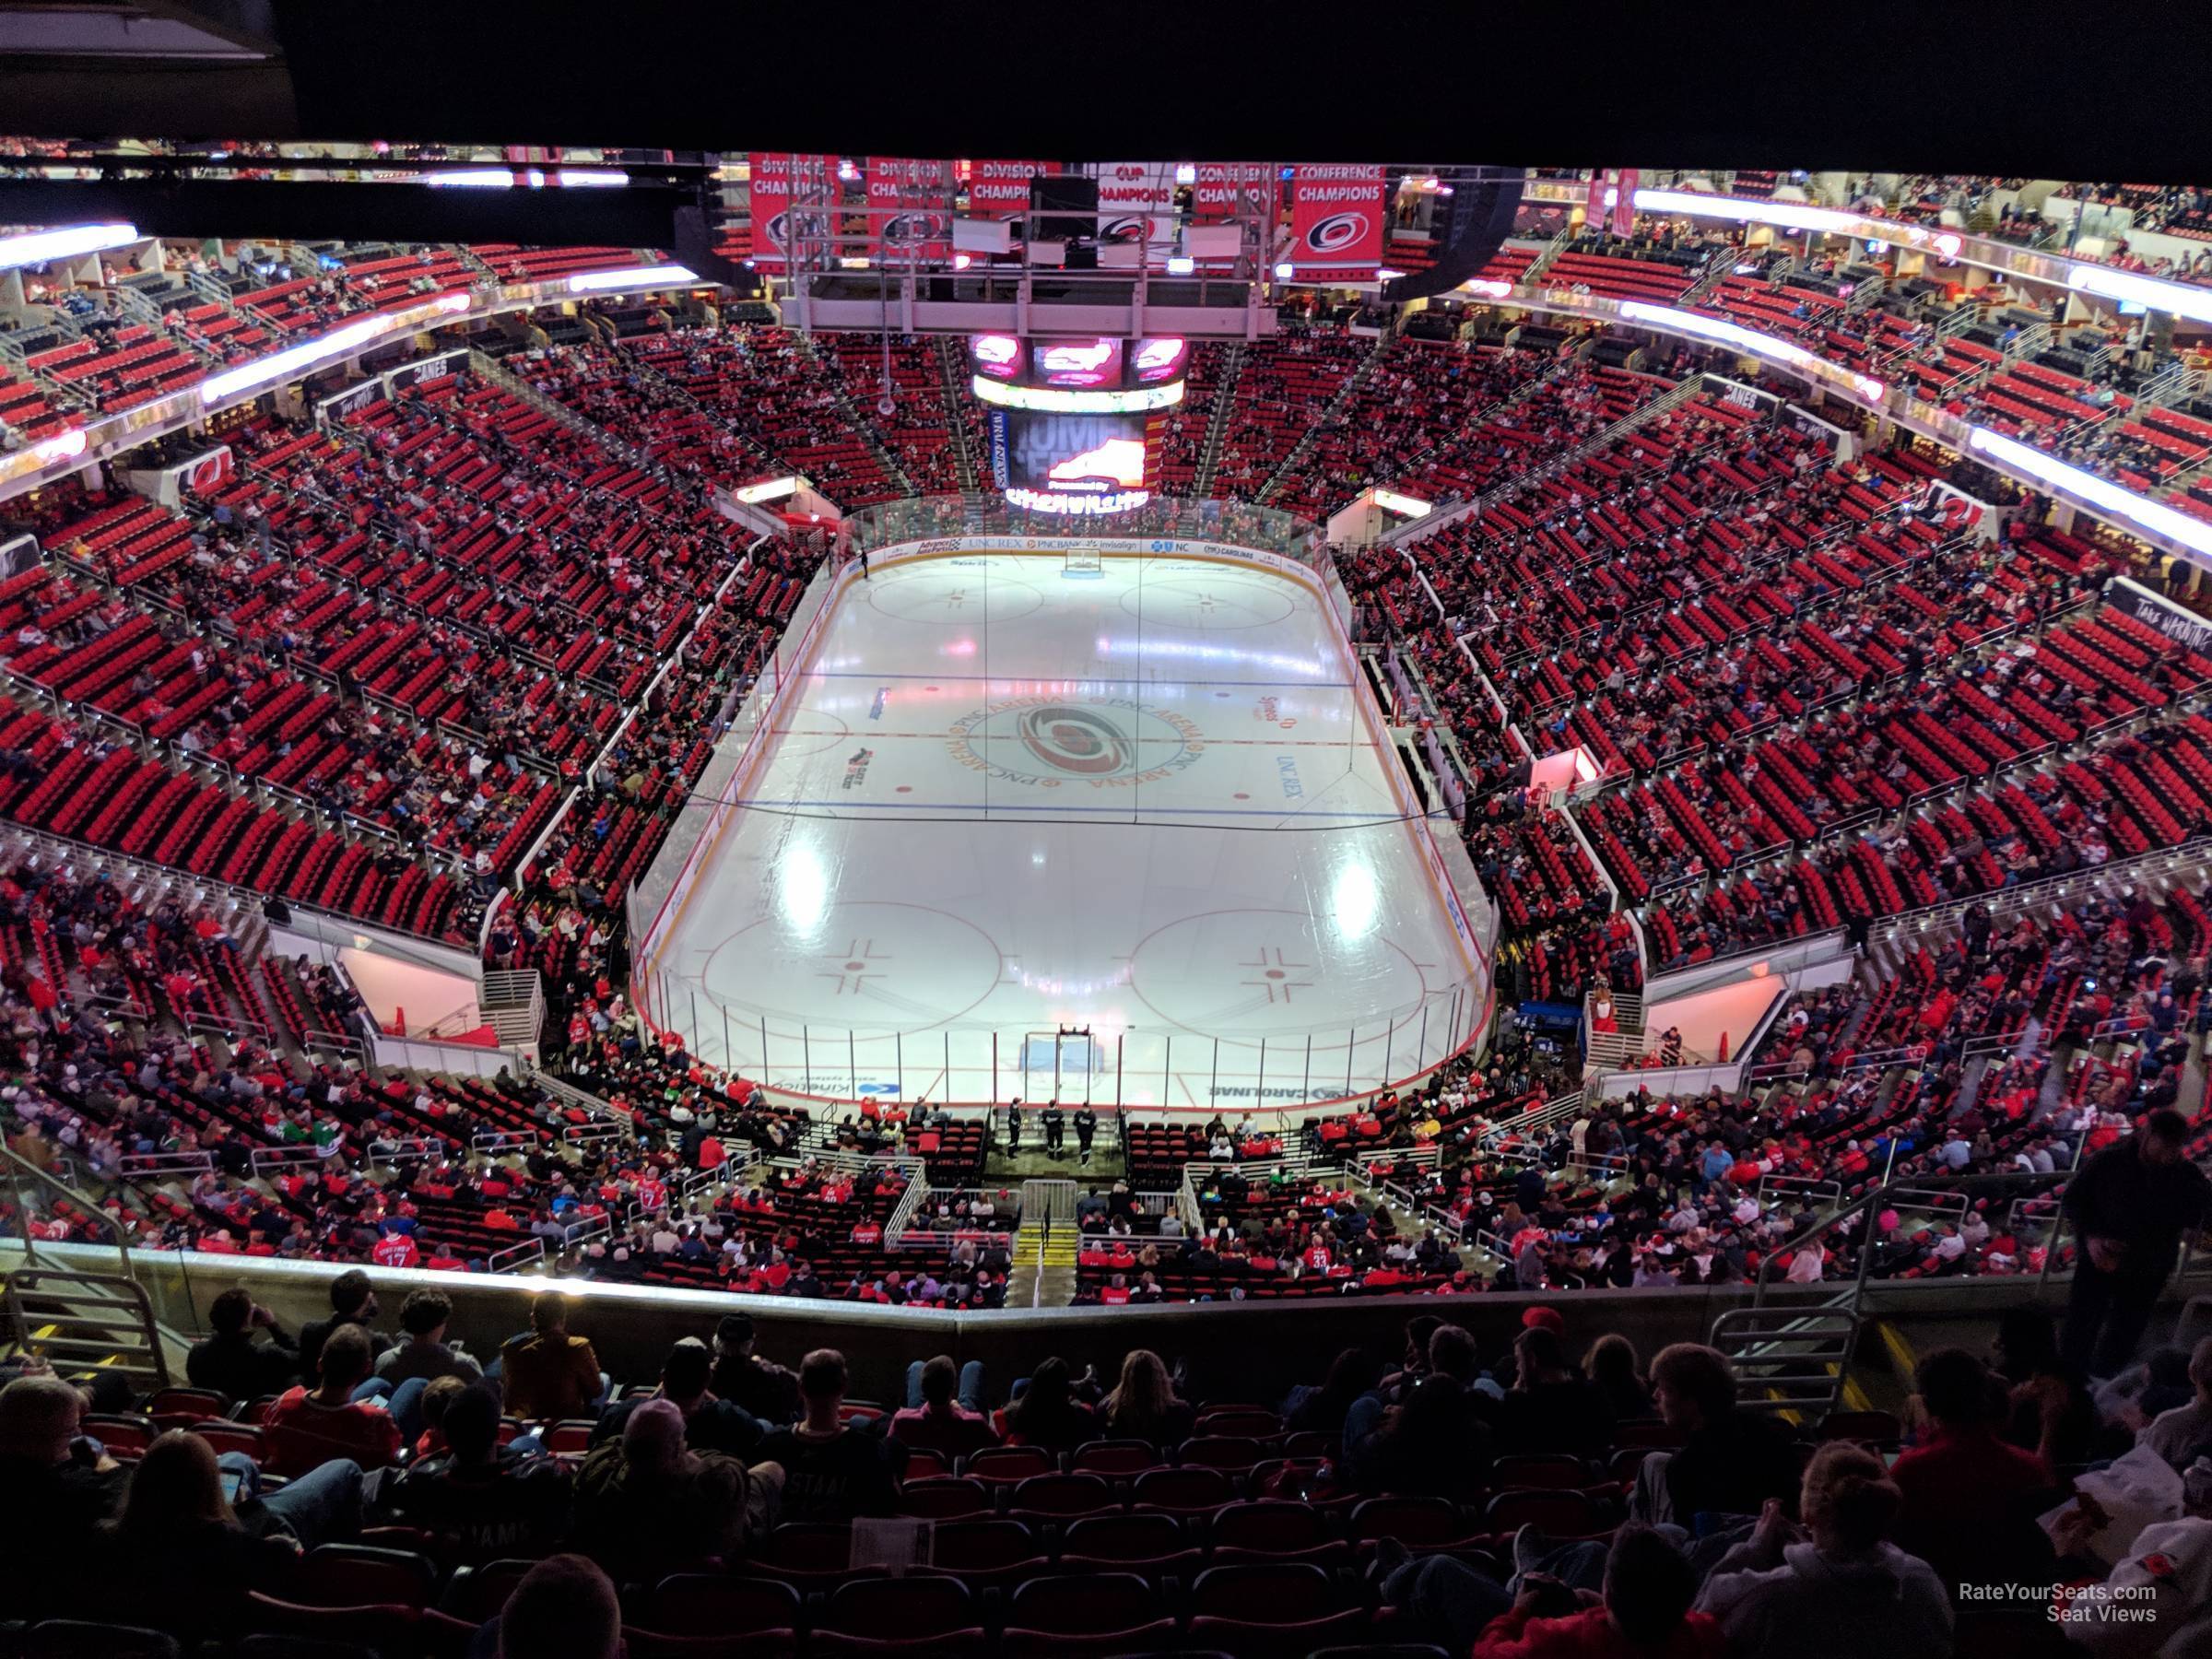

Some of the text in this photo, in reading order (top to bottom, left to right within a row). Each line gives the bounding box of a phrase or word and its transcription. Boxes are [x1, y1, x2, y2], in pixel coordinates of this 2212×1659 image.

[982, 163, 1047, 179] DIVISION
[1115, 166, 1145, 182] CUP
[1199, 167, 1281, 182] CONFEENC
[1300, 165, 1381, 180] CONFERENCE
[1099, 186, 1170, 204] HAMPIONS
[1198, 188, 1278, 203] CHAMIONS
[1299, 185, 1380, 202] CHAMPIONS
[414, 359, 448, 384] CANES
[1724, 384, 1758, 409] CANES
[969, 539, 1022, 548] UNC REX
[1176, 543, 1189, 552] NC
[988, 696, 1063, 713] ARENA
[771, 1081, 851, 1094] Kinetico
[1209, 1086, 1308, 1100] CAROLINAS
[1313, 1254, 1327, 1268] 33
